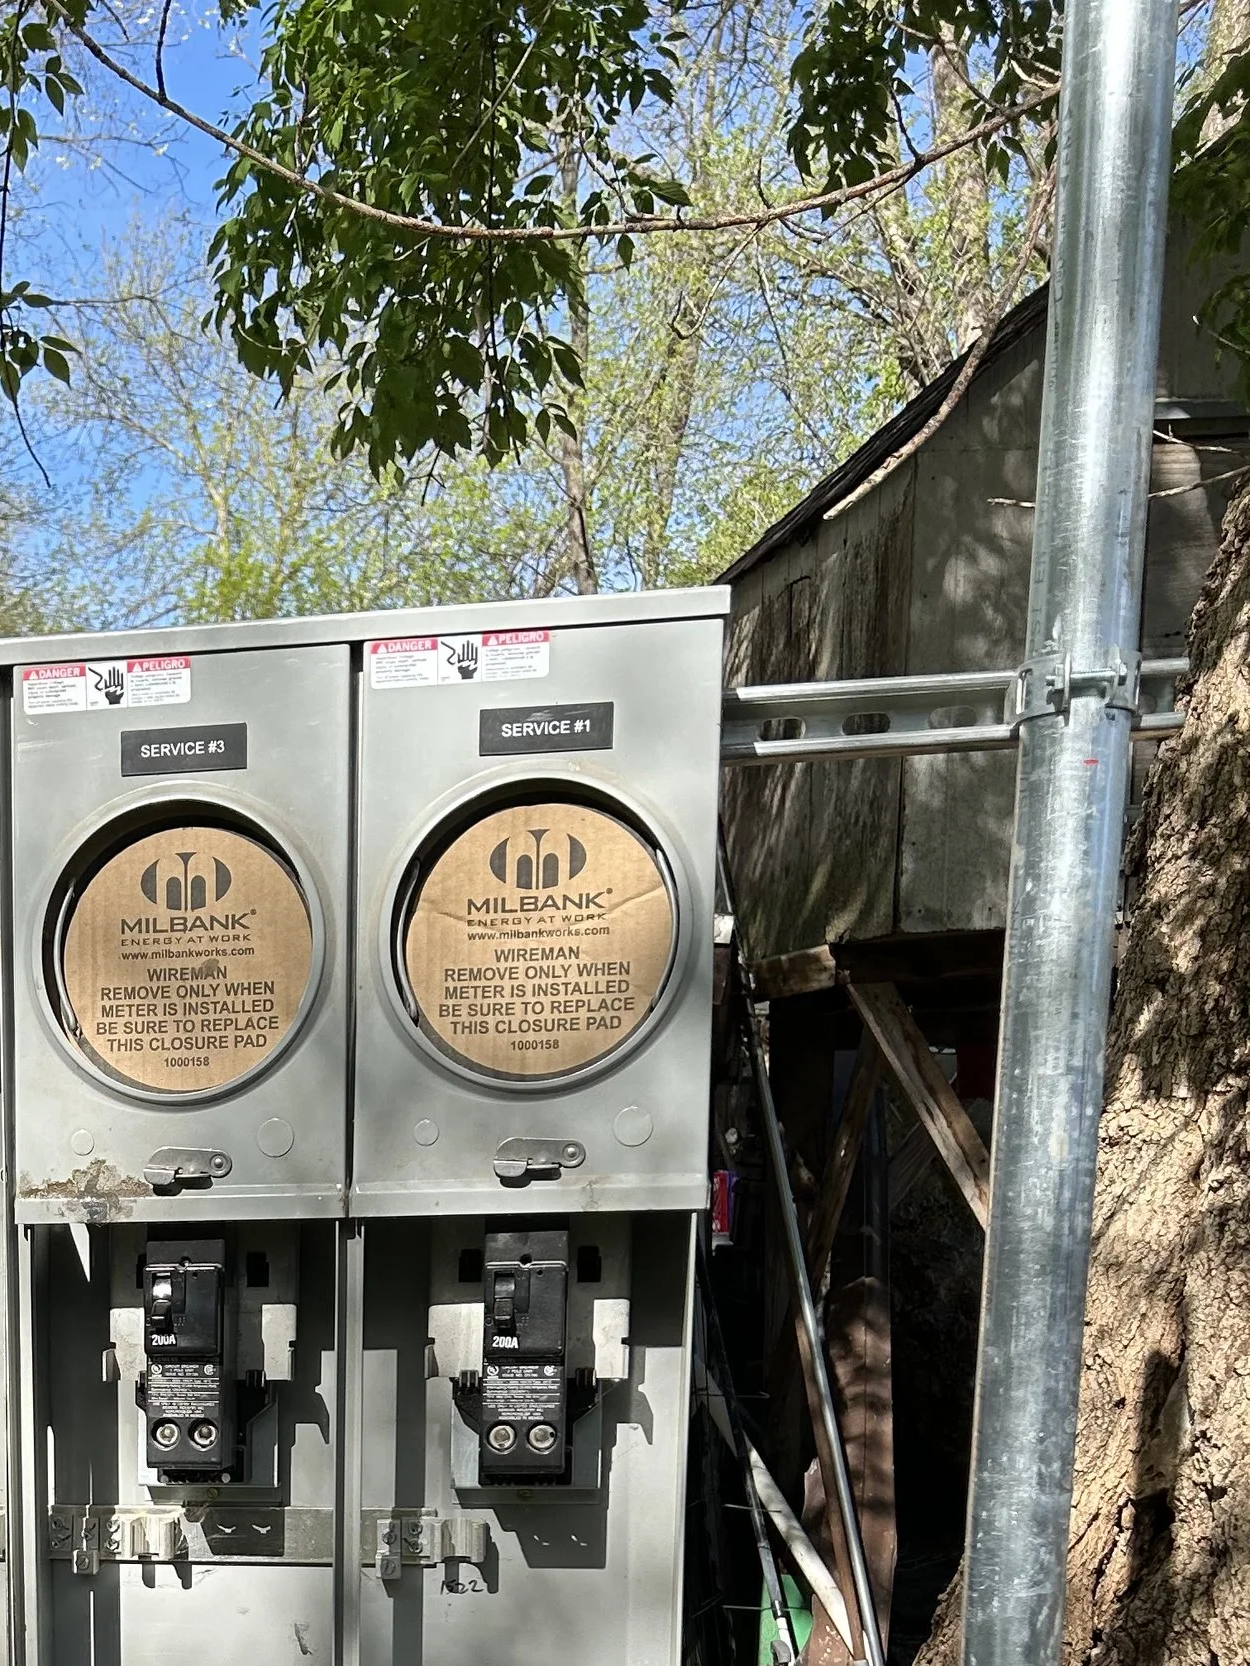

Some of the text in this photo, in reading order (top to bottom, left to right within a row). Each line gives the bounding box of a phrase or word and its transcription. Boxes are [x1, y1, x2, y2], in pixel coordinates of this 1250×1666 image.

[499, 632, 543, 643] PELIGRO
[389, 640, 432, 651] DANGER
[143, 659, 185, 671] PELIGRO
[39, 668, 80, 678] DANGER
[502, 719, 590, 737] SERVICE #1
[141, 740, 225, 758] SERVICE #3
[467, 913, 607, 926] ENERGY AT WORK
[121, 937, 181, 946] ENERGY
[209, 934, 251, 942] WORK
[467, 926, 610, 941] www.milbankworks.com
[121, 947, 254, 960] www.milbankworks.com
[495, 946, 580, 962] WIREMAN
[147, 966, 227, 982] WIREMAN
[444, 961, 631, 982] REMOVE ONLY WHEN
[101, 981, 275, 1000] REMOVE ONLY WHEN
[445, 980, 630, 1000] METER IS INSTALLED
[102, 999, 274, 1017] METER IS INSTALLED
[439, 997, 635, 1017] BE SURE TO REPLACE
[96, 1016, 279, 1035] BE SURE TO REPLACE
[450, 1015, 621, 1035] THIS CLOSURE PAD
[107, 1034, 267, 1052] THIS CLOSURE PAD
[510, 1039, 559, 1051] 1000158
[164, 1057, 209, 1067] 1000158
[152, 1334, 176, 1346] 200A
[492, 1336, 518, 1348] 200A
